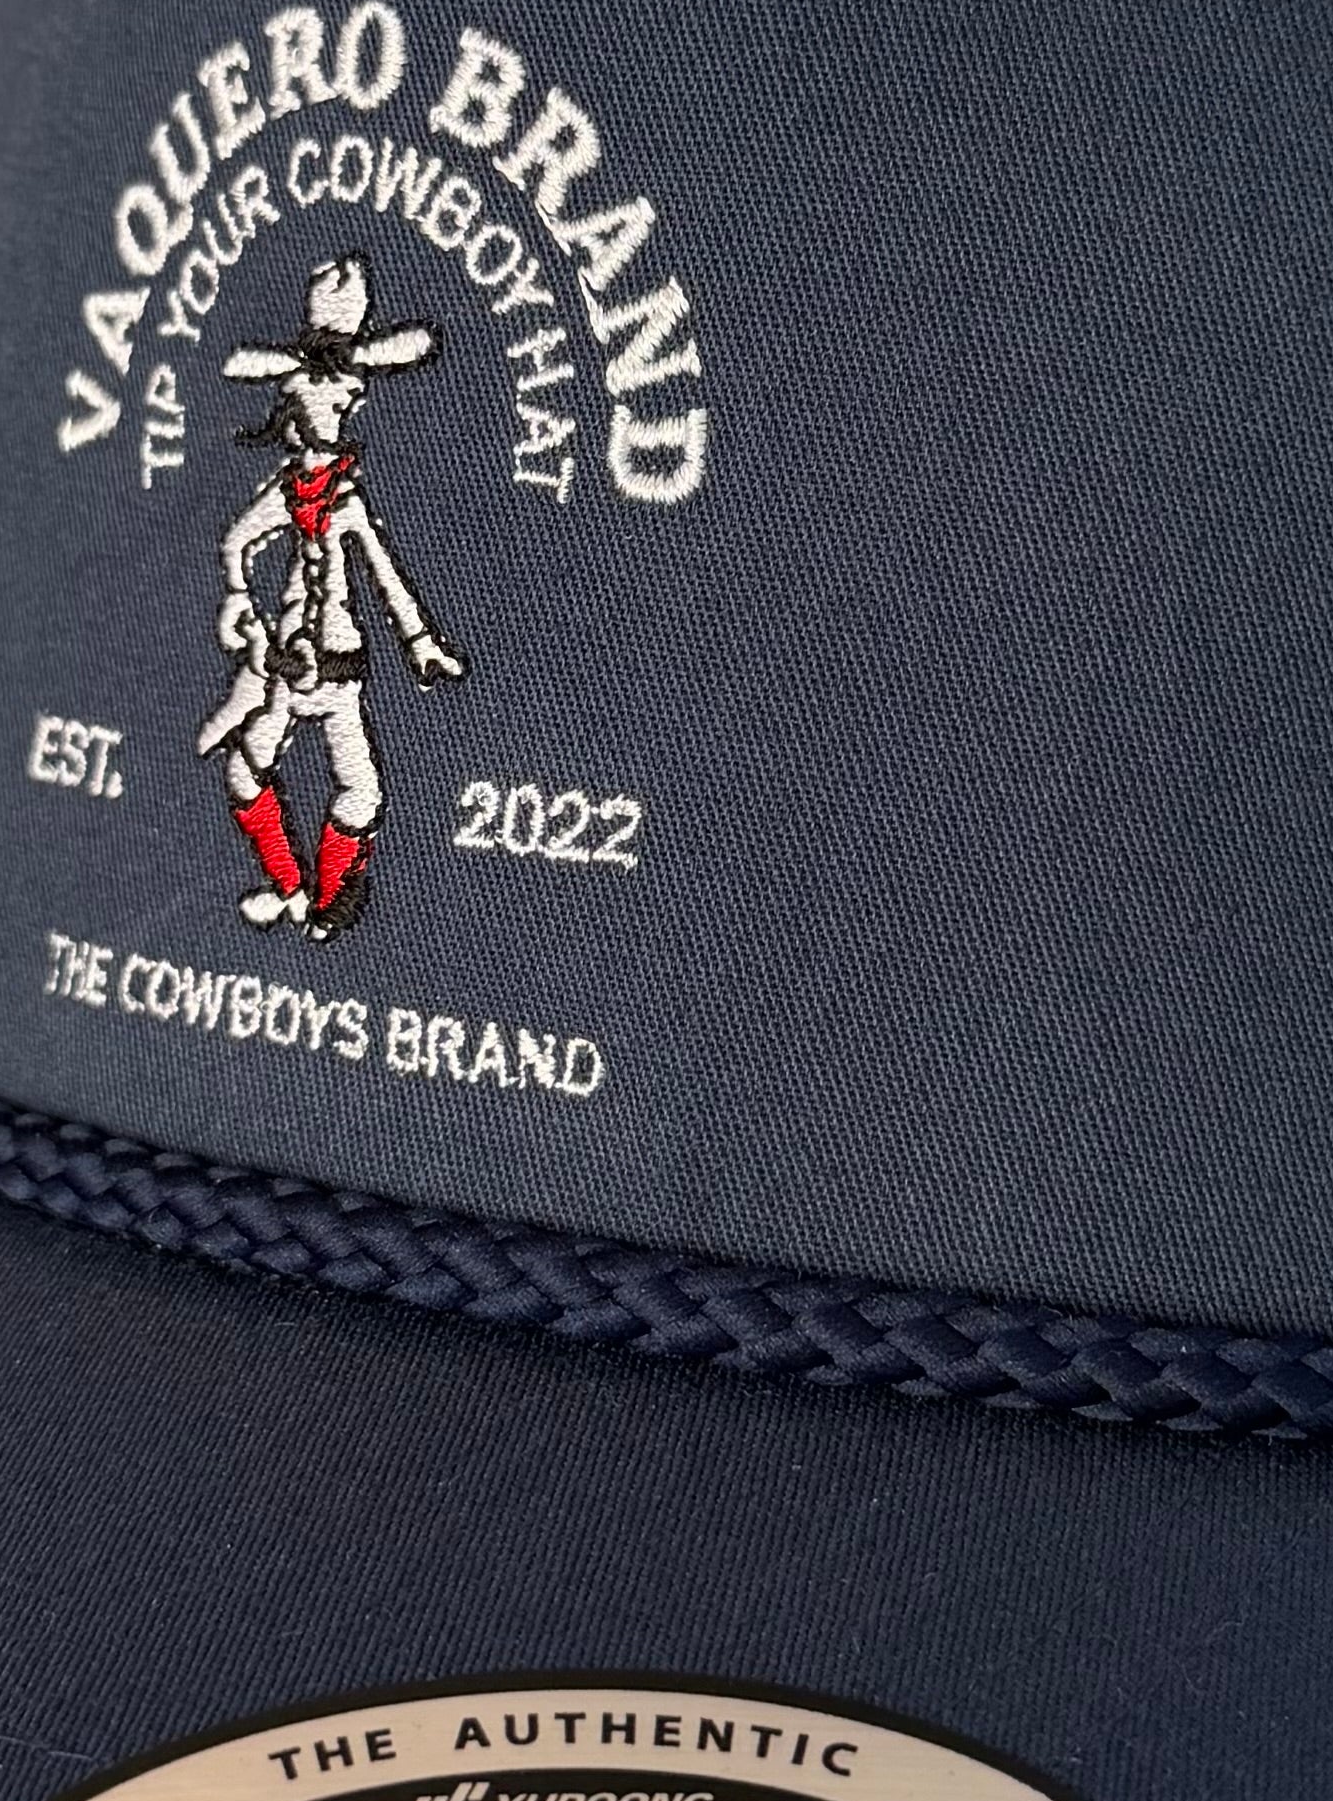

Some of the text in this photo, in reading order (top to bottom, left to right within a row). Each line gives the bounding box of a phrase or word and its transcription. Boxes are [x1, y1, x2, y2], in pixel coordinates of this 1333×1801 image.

[58, 1, 406, 451] VAQUERO
[430, 28, 707, 504] BRAND
[141, 135, 576, 504] TIP YOUR COWBOY HAT
[28, 711, 643, 869] EST. 2022
[43, 932, 605, 1098] THE COWBOYS BRAND
[269, 1712, 862, 1780] THE AUTHENTIC
